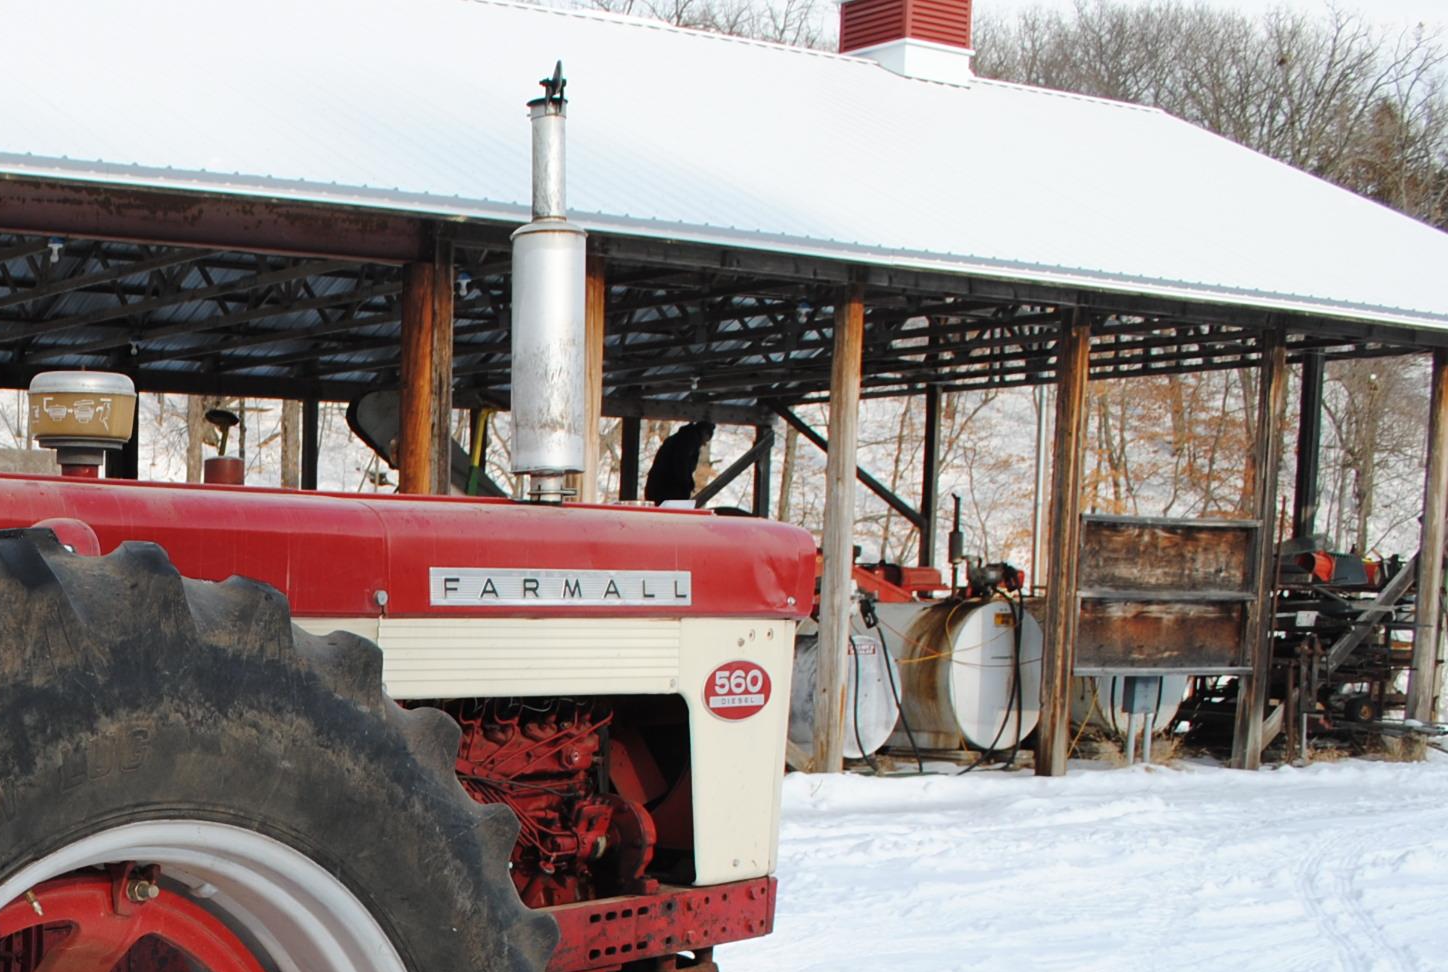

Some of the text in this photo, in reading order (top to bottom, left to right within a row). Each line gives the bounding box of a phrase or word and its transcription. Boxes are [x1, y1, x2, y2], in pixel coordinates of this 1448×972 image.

[442, 577, 688, 600] FARMALL
[714, 669, 764, 695] 560
[720, 697, 756, 706] DIESEL
